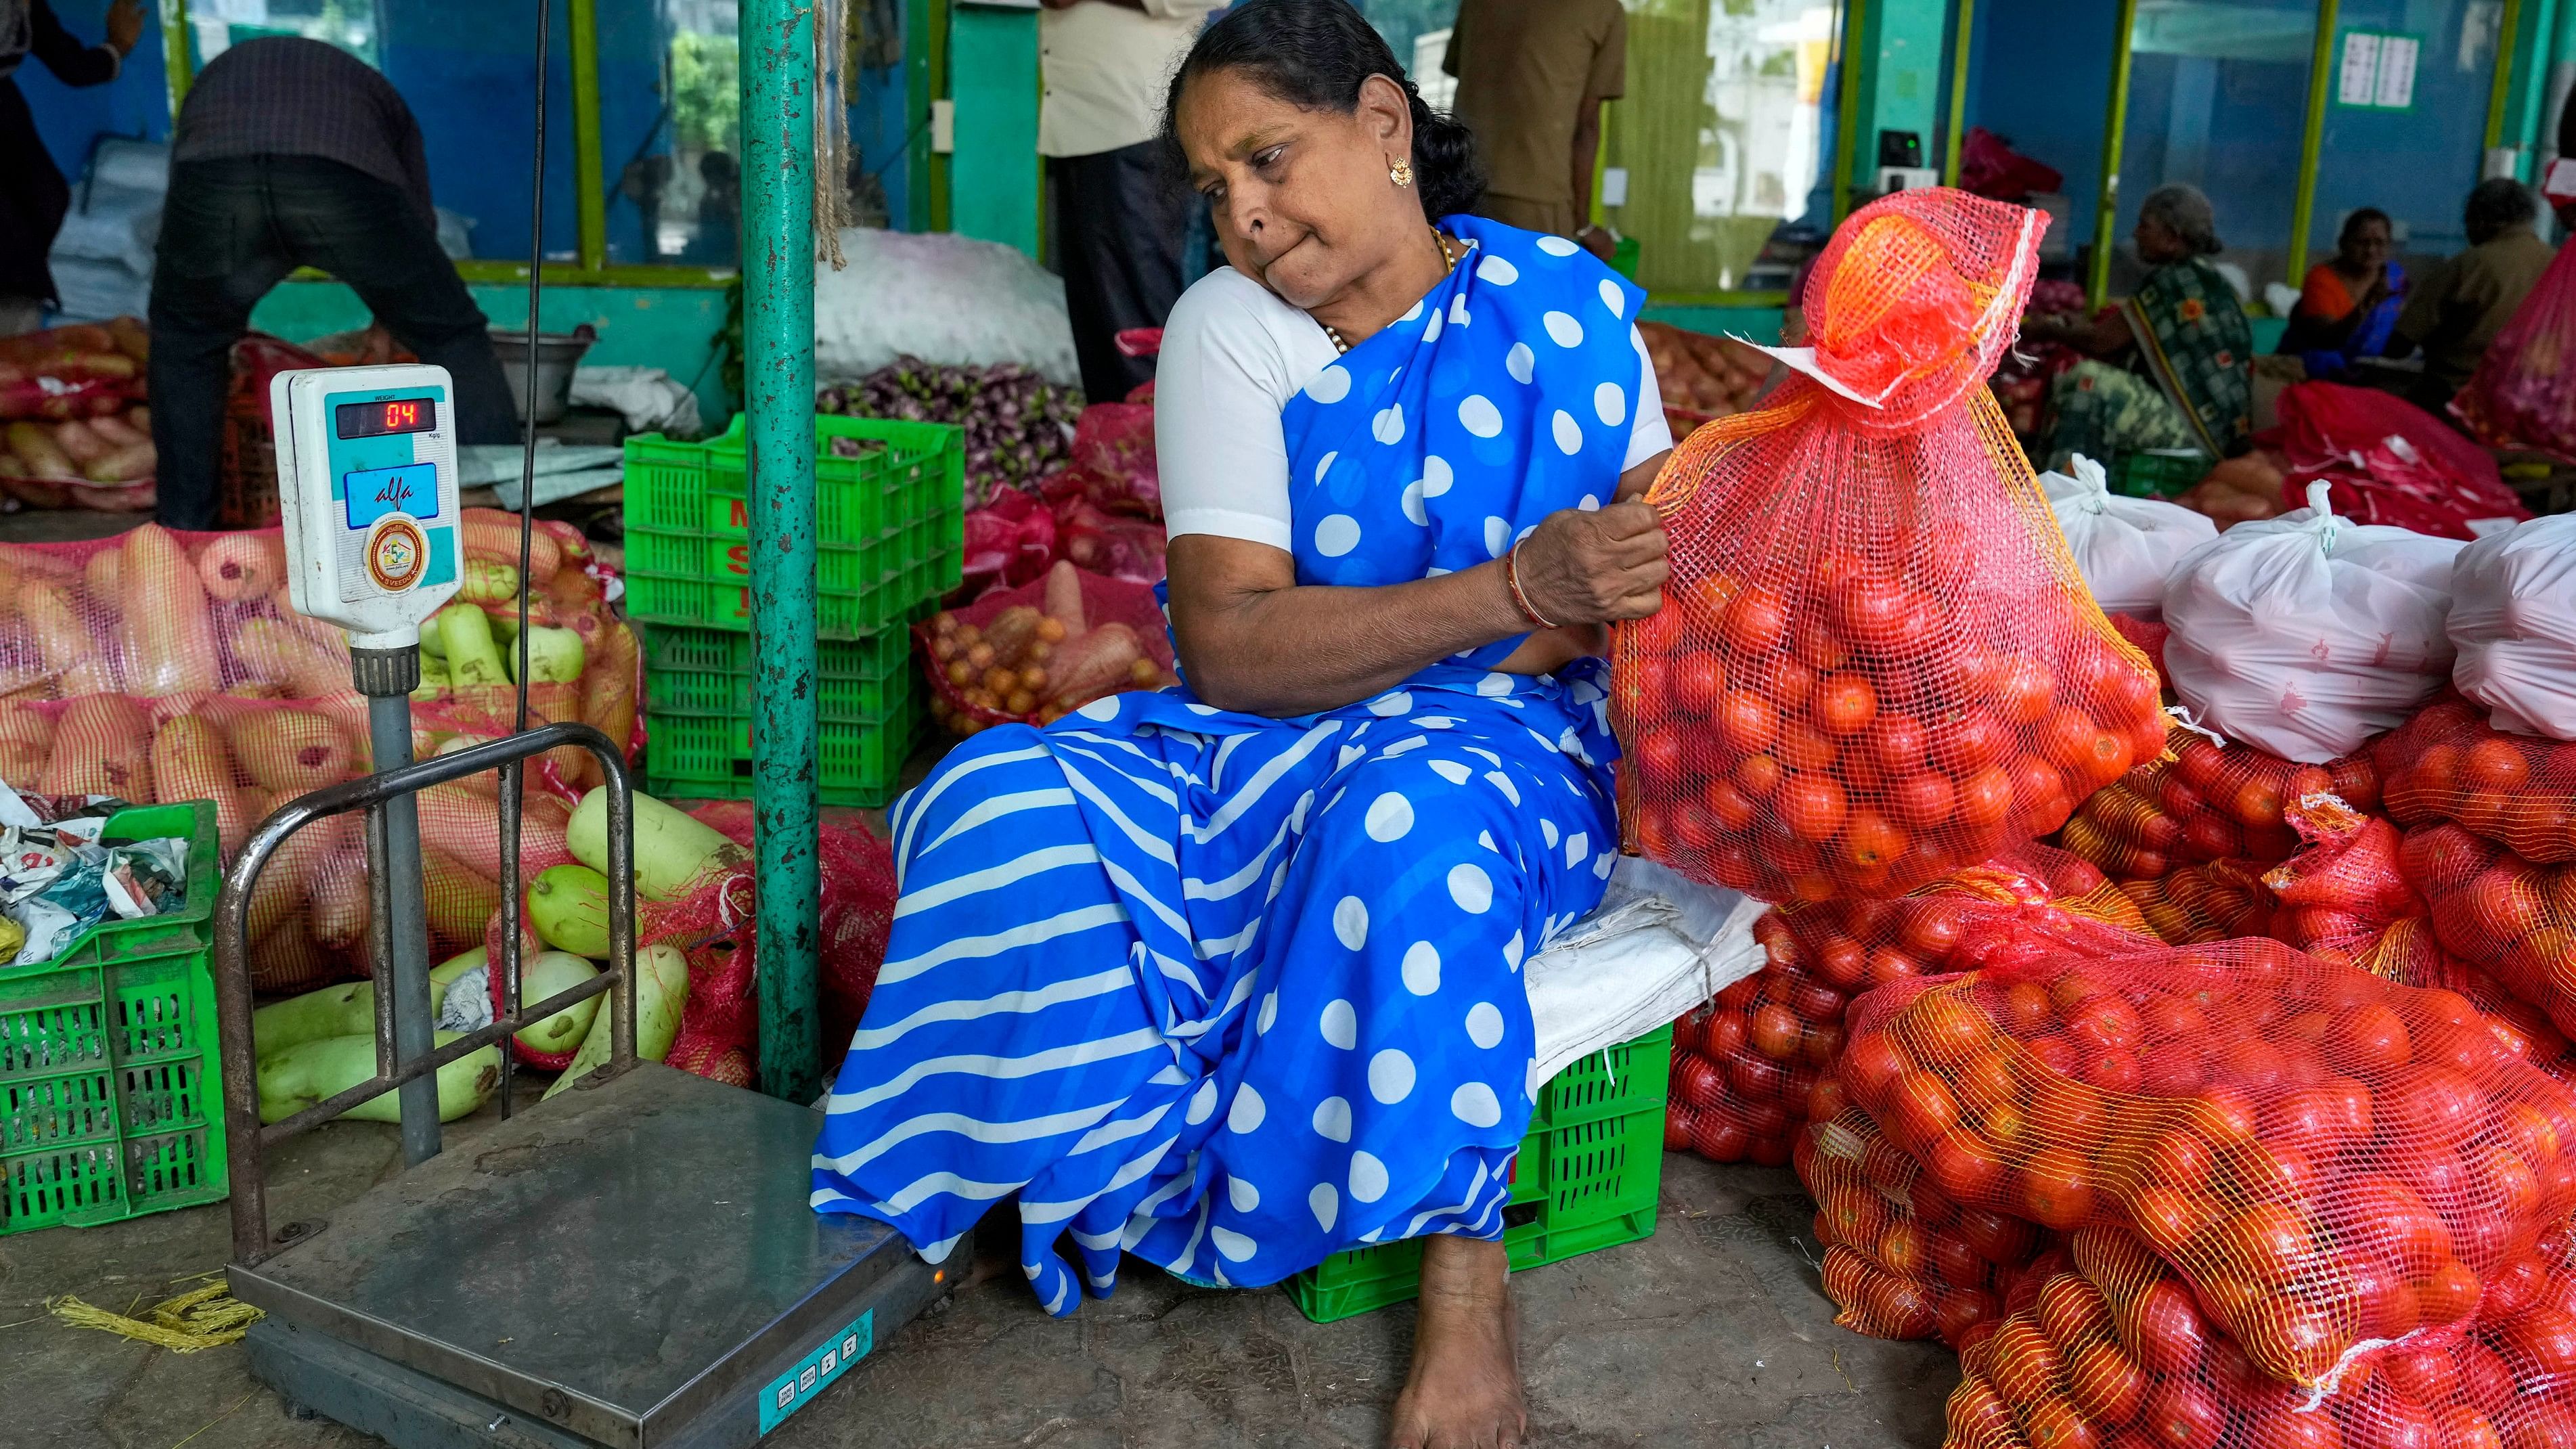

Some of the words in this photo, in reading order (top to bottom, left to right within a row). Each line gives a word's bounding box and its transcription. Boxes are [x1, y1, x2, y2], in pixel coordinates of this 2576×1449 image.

[386, 403, 414, 427] 04
[374, 476, 414, 512] alfa
[390, 574, 412, 586] VEEDU
[801, 1375, 815, 1388] ENTER
[802, 1370, 814, 1381] MODE
[782, 1386, 792, 1396] TARE
